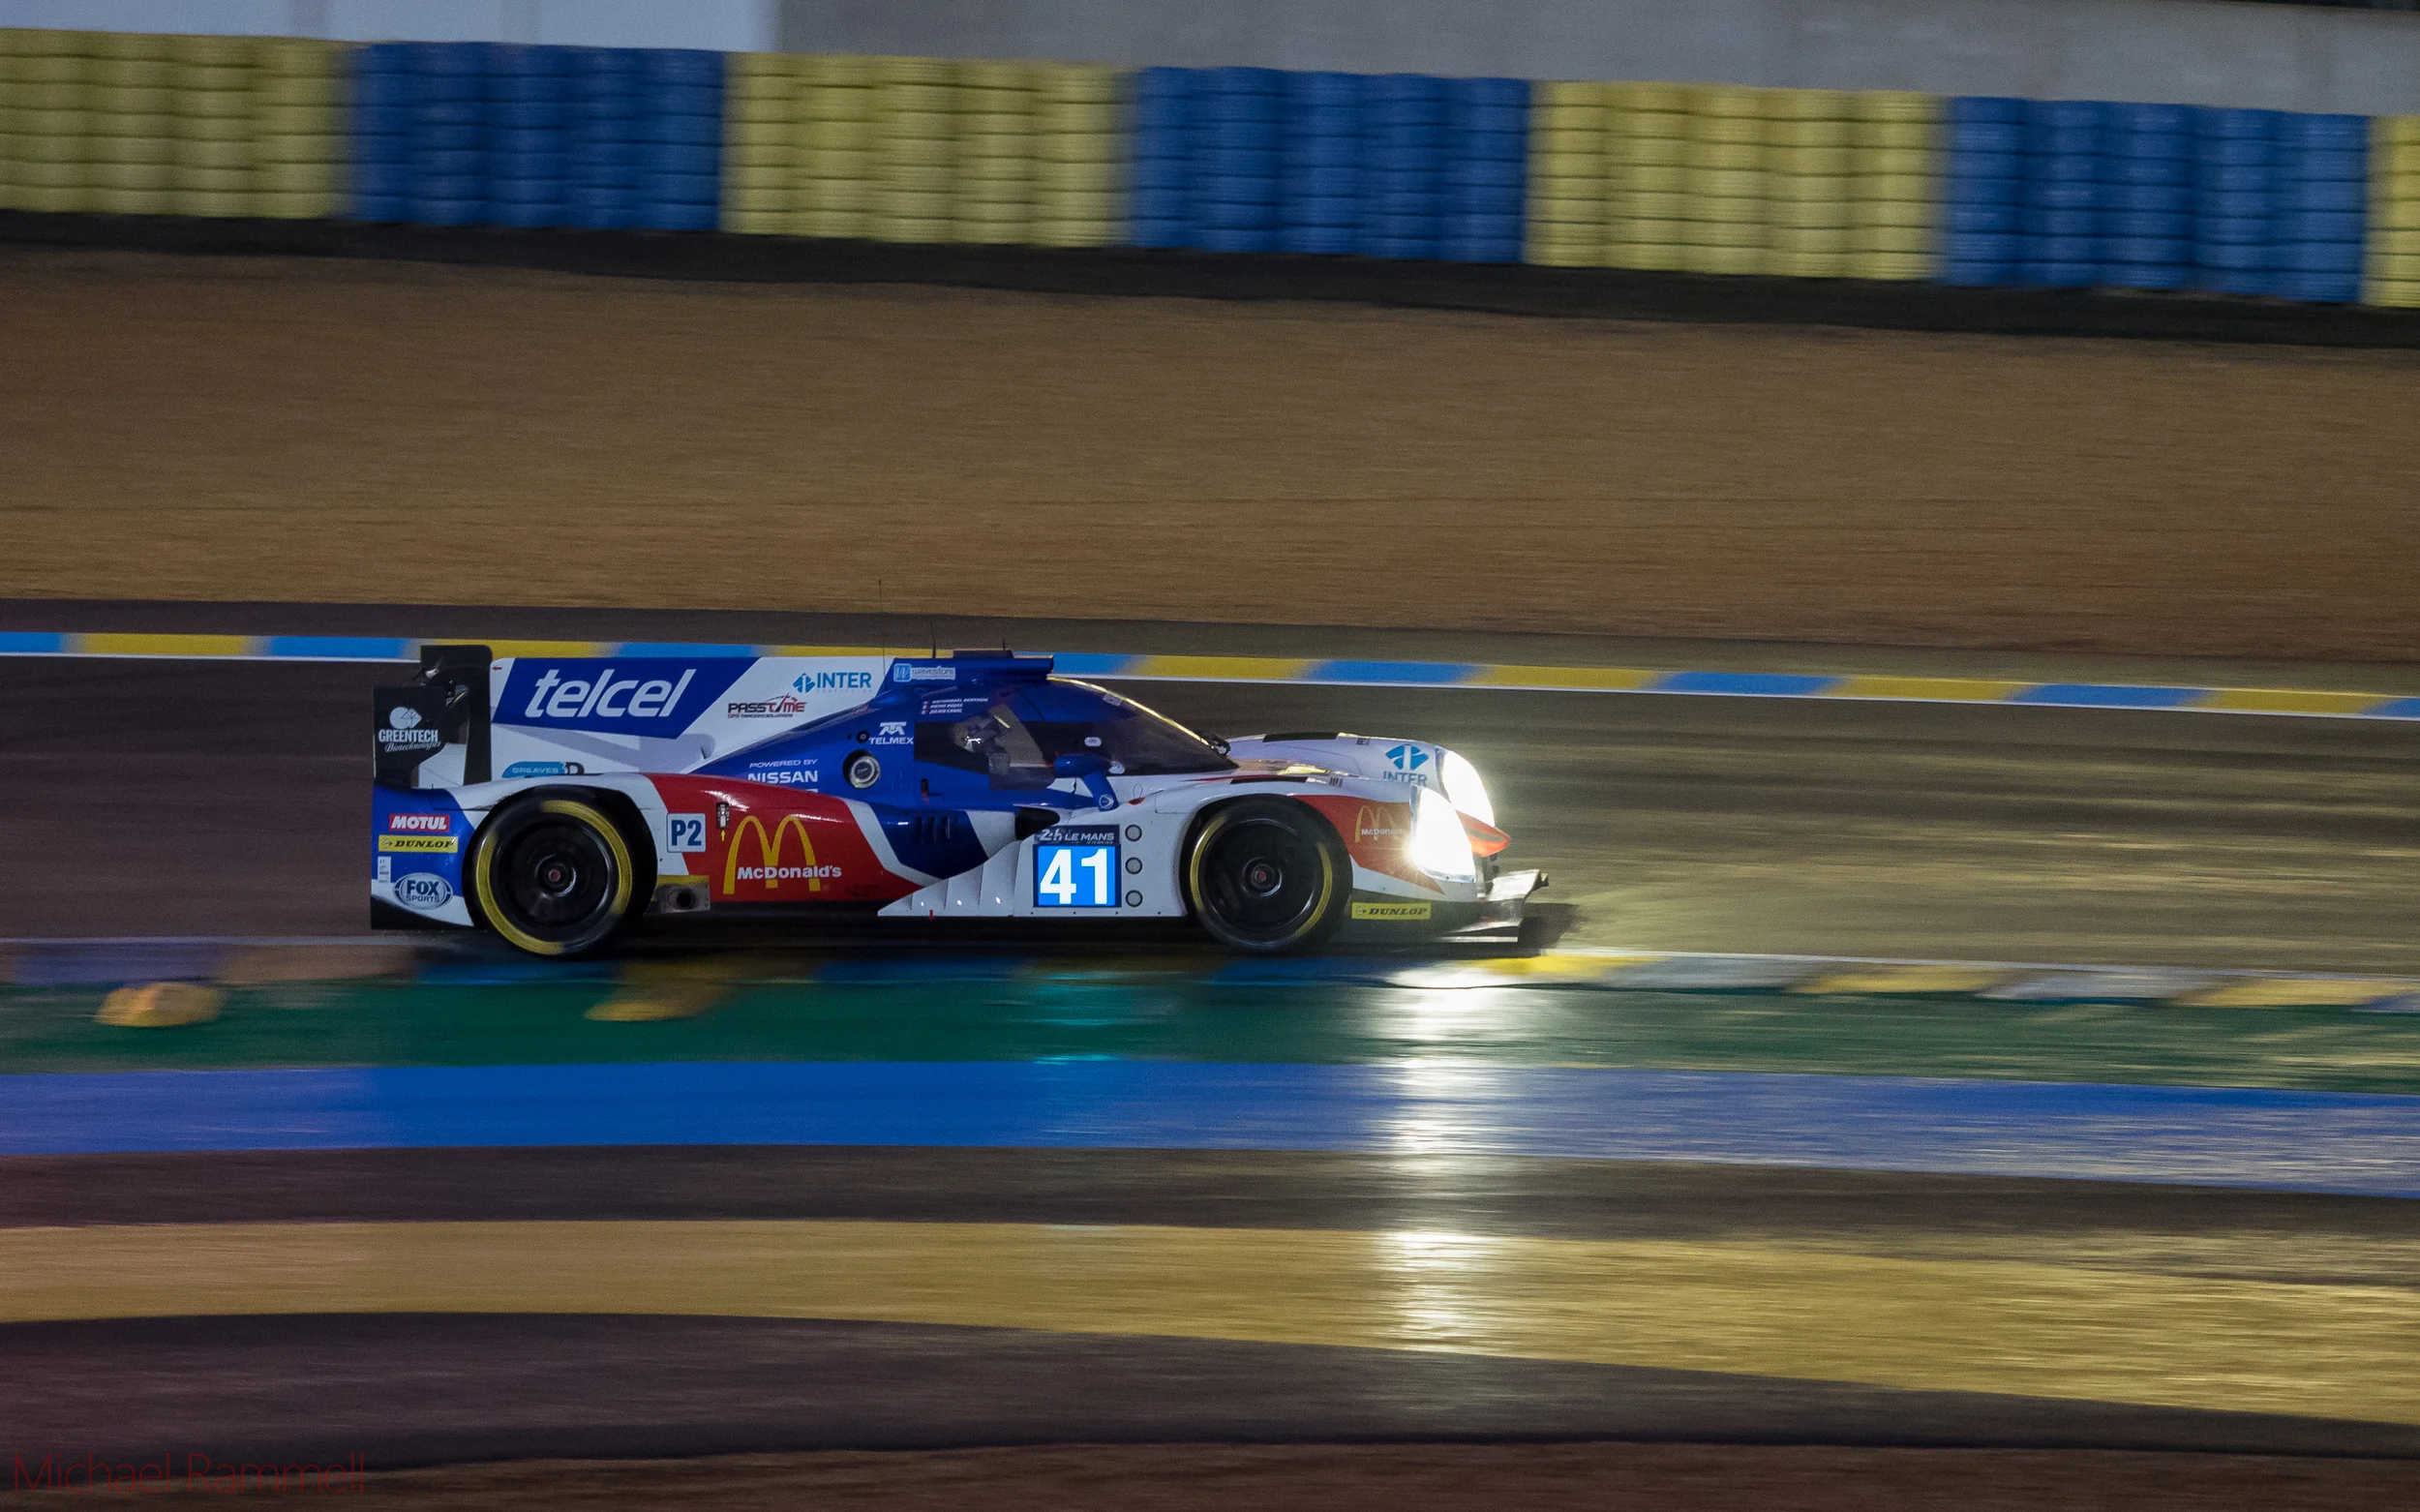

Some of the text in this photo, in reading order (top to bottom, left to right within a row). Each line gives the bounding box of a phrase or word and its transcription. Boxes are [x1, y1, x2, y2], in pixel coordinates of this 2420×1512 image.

[817, 673, 872, 688] INTER
[525, 669, 697, 717] telcel
[378, 729, 439, 742] GREENTECH
[748, 771, 818, 784] NISSAN
[391, 816, 447, 830] MOTUL
[671, 820, 702, 846] P2
[1065, 832, 1079, 841] LE
[1080, 832, 1115, 841] MANS
[737, 865, 842, 880] McDonald's
[1040, 848, 1108, 905] 41
[407, 880, 439, 896] FOX
